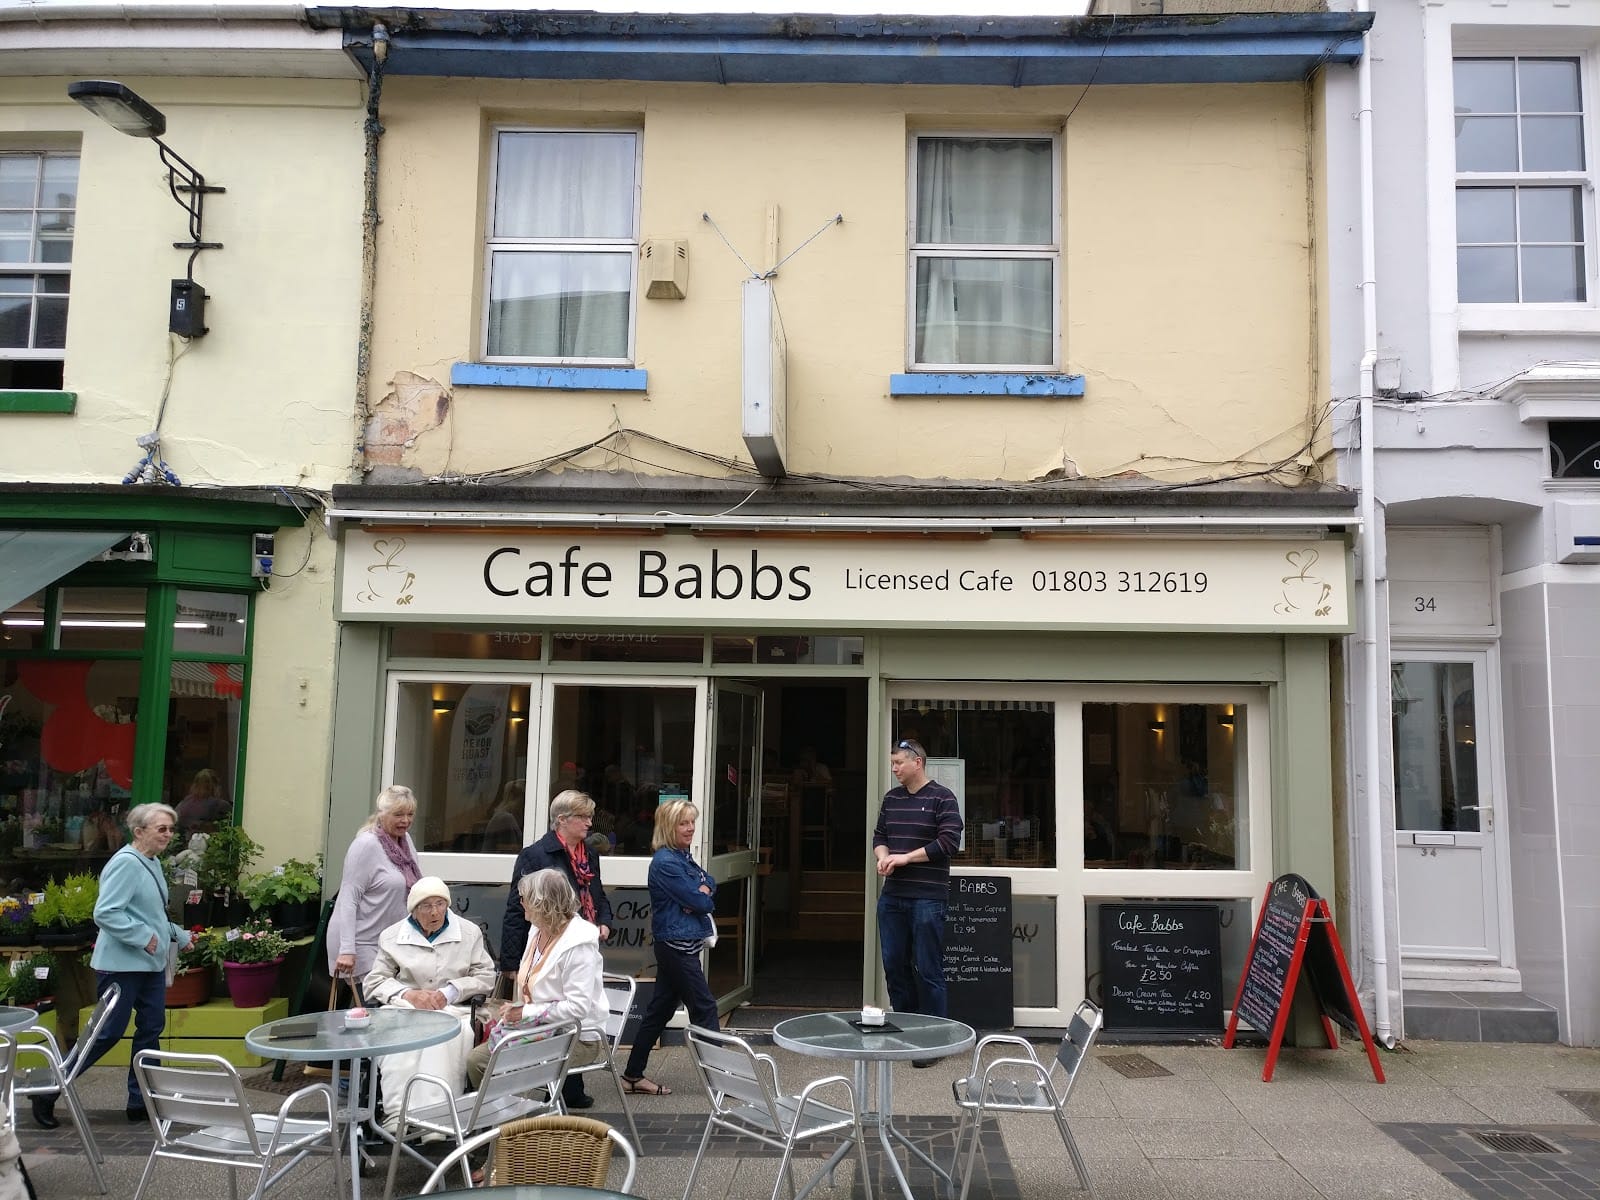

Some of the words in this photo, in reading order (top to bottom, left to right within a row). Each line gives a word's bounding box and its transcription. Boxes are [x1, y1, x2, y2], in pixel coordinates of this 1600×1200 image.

[483, 545, 612, 598] Cafe
[637, 548, 812, 601] Babbs
[845, 568, 950, 591] Licensed
[958, 569, 1013, 591] Cafe
[1032, 570, 1108, 592] 01803
[1117, 571, 1209, 593] 312619
[1414, 596, 1437, 612] 34
[959, 879, 998, 894] BABBS
[1273, 880, 1289, 897] CAFE
[1118, 911, 1146, 934] Cafe
[1151, 913, 1184, 932] Babbs
[1111, 985, 1134, 998] Devon
[1135, 987, 1157, 998] Cream
[1160, 988, 1173, 998] Tea
